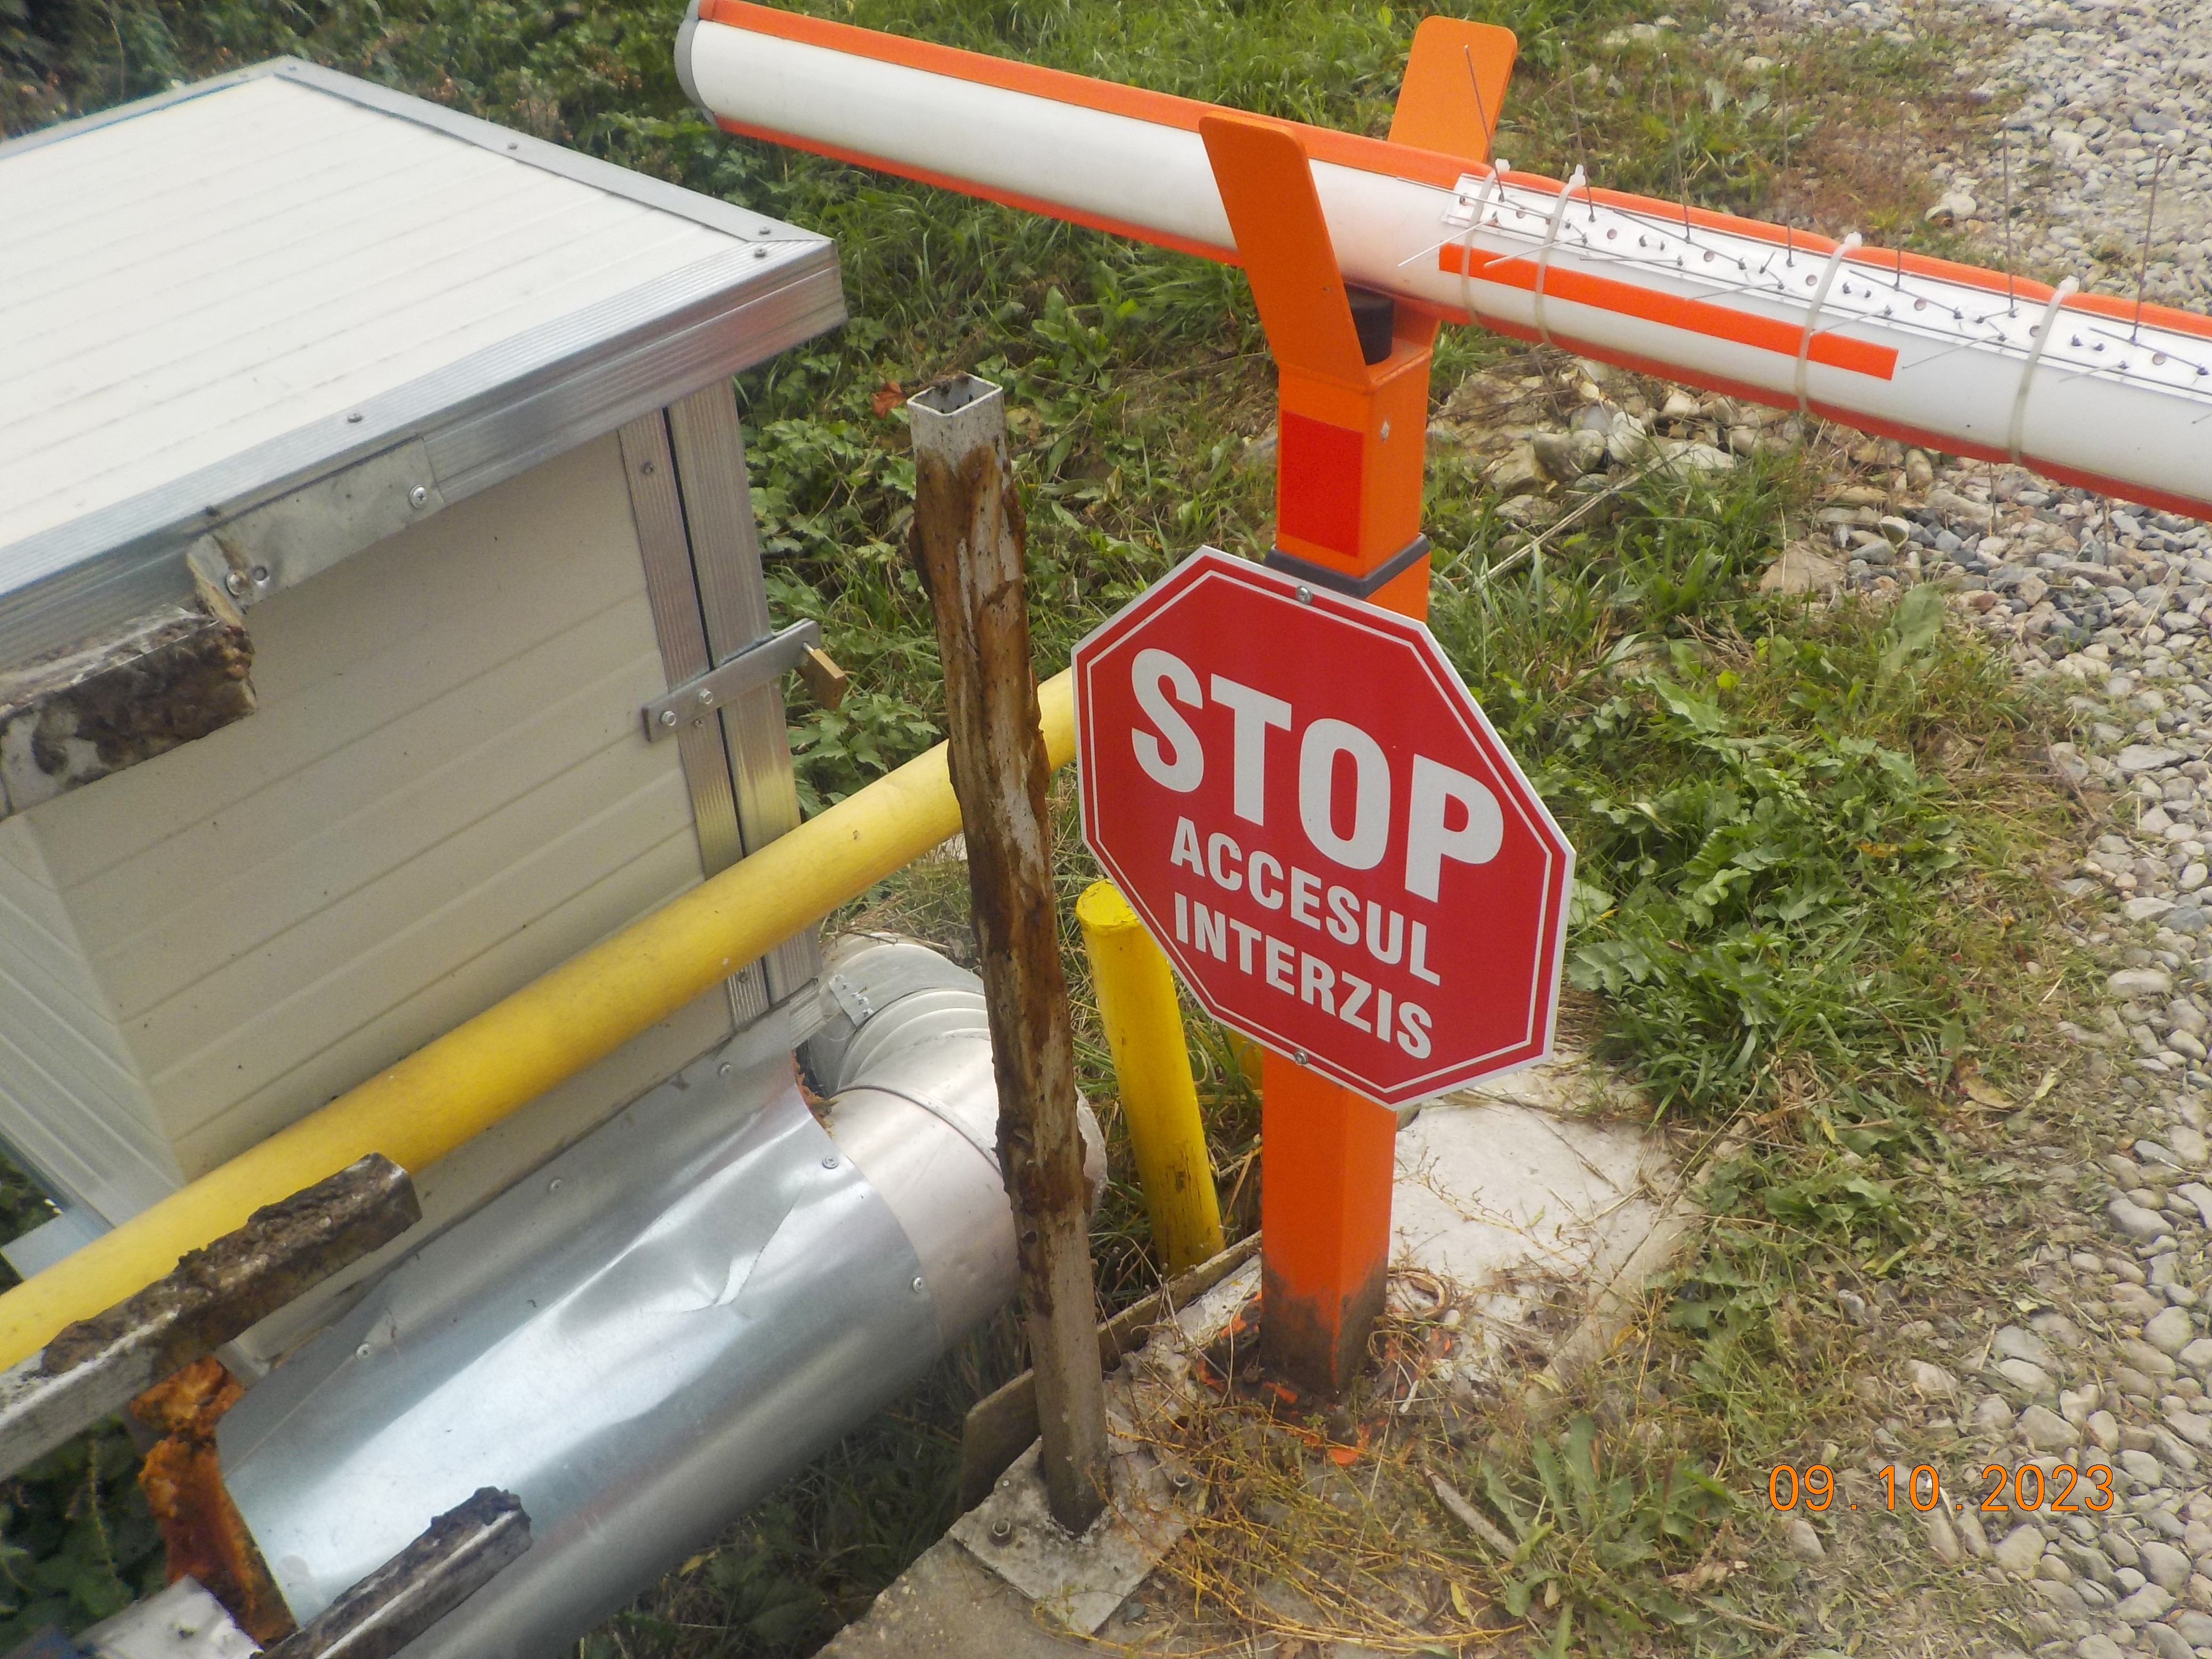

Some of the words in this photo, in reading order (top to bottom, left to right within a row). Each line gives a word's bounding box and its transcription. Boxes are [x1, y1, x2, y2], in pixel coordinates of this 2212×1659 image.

[1132, 648, 1504, 903] STOP
[1170, 816, 1440, 986] ACCESUL
[1175, 892, 1432, 1059] INTERZIS
